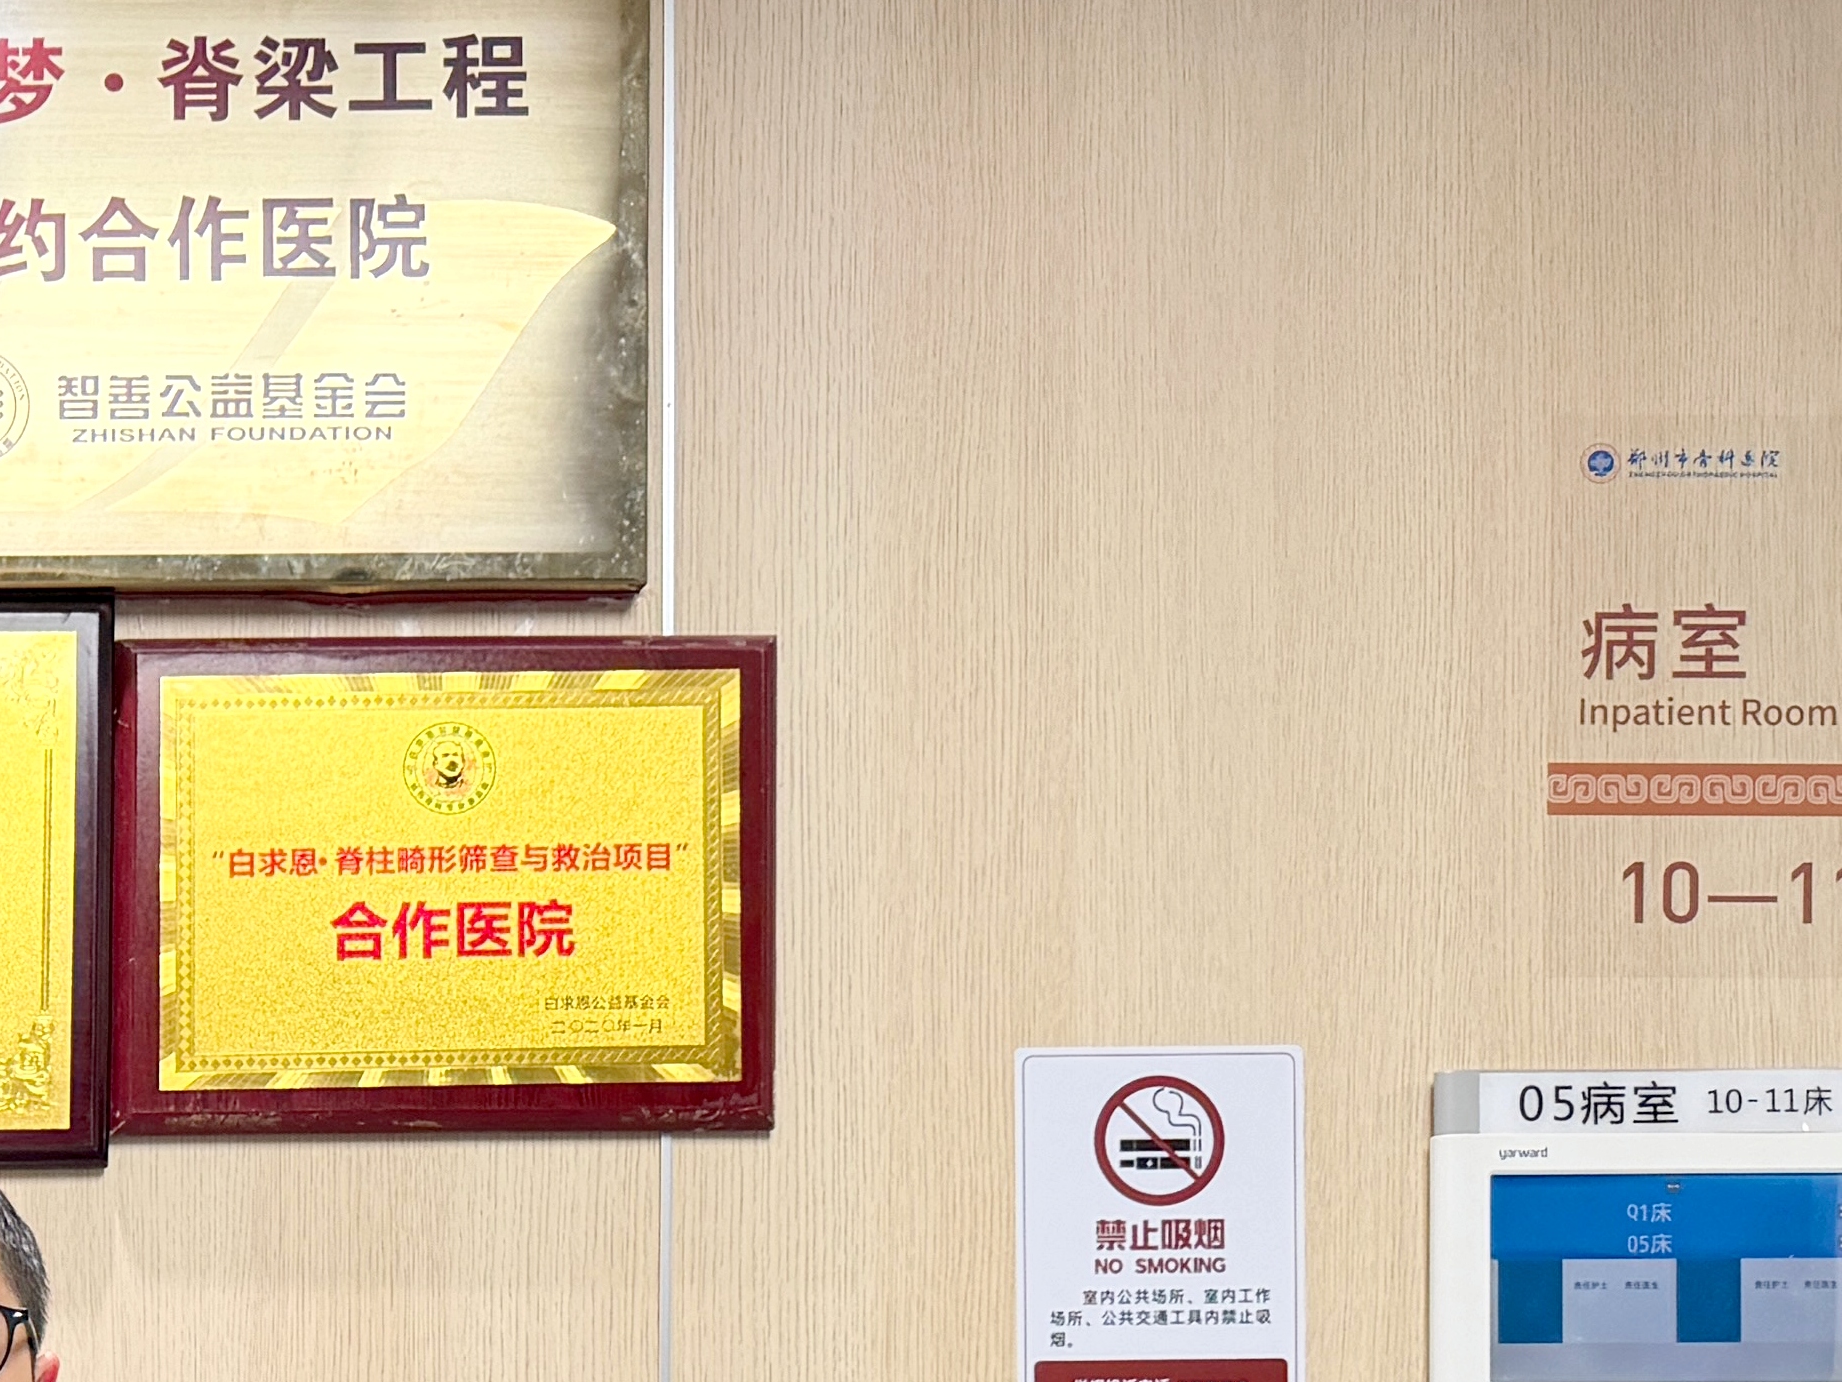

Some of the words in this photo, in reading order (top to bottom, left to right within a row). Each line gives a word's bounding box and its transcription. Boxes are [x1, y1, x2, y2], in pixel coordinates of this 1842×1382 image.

[58, 372, 406, 420] 智善公益基金会
[72, 427, 196, 443] ZHISHAN
[211, 425, 393, 441] FOUNDATION
[1580, 603, 1747, 680] 病室
[1579, 697, 1731, 732] Inpatient
[1741, 698, 1838, 727] Room
[1622, 861, 1842, 925] 10—1
[331, 901, 576, 962] 合作医院
[1518, 1080, 1679, 1126] 05病室
[1706, 1086, 1834, 1116] 10-11床
[1498, 1146, 1549, 1161] yarward
[1095, 1218, 1226, 1251] 禁止吸烟
[1094, 1258, 1123, 1274] NO
[1134, 1257, 1226, 1274] SMOKING
[1082, 1288, 1271, 1306] 室内公共场所、室内工作
[1050, 1308, 1272, 1327] 场所、公共交通工具内禁止吸
